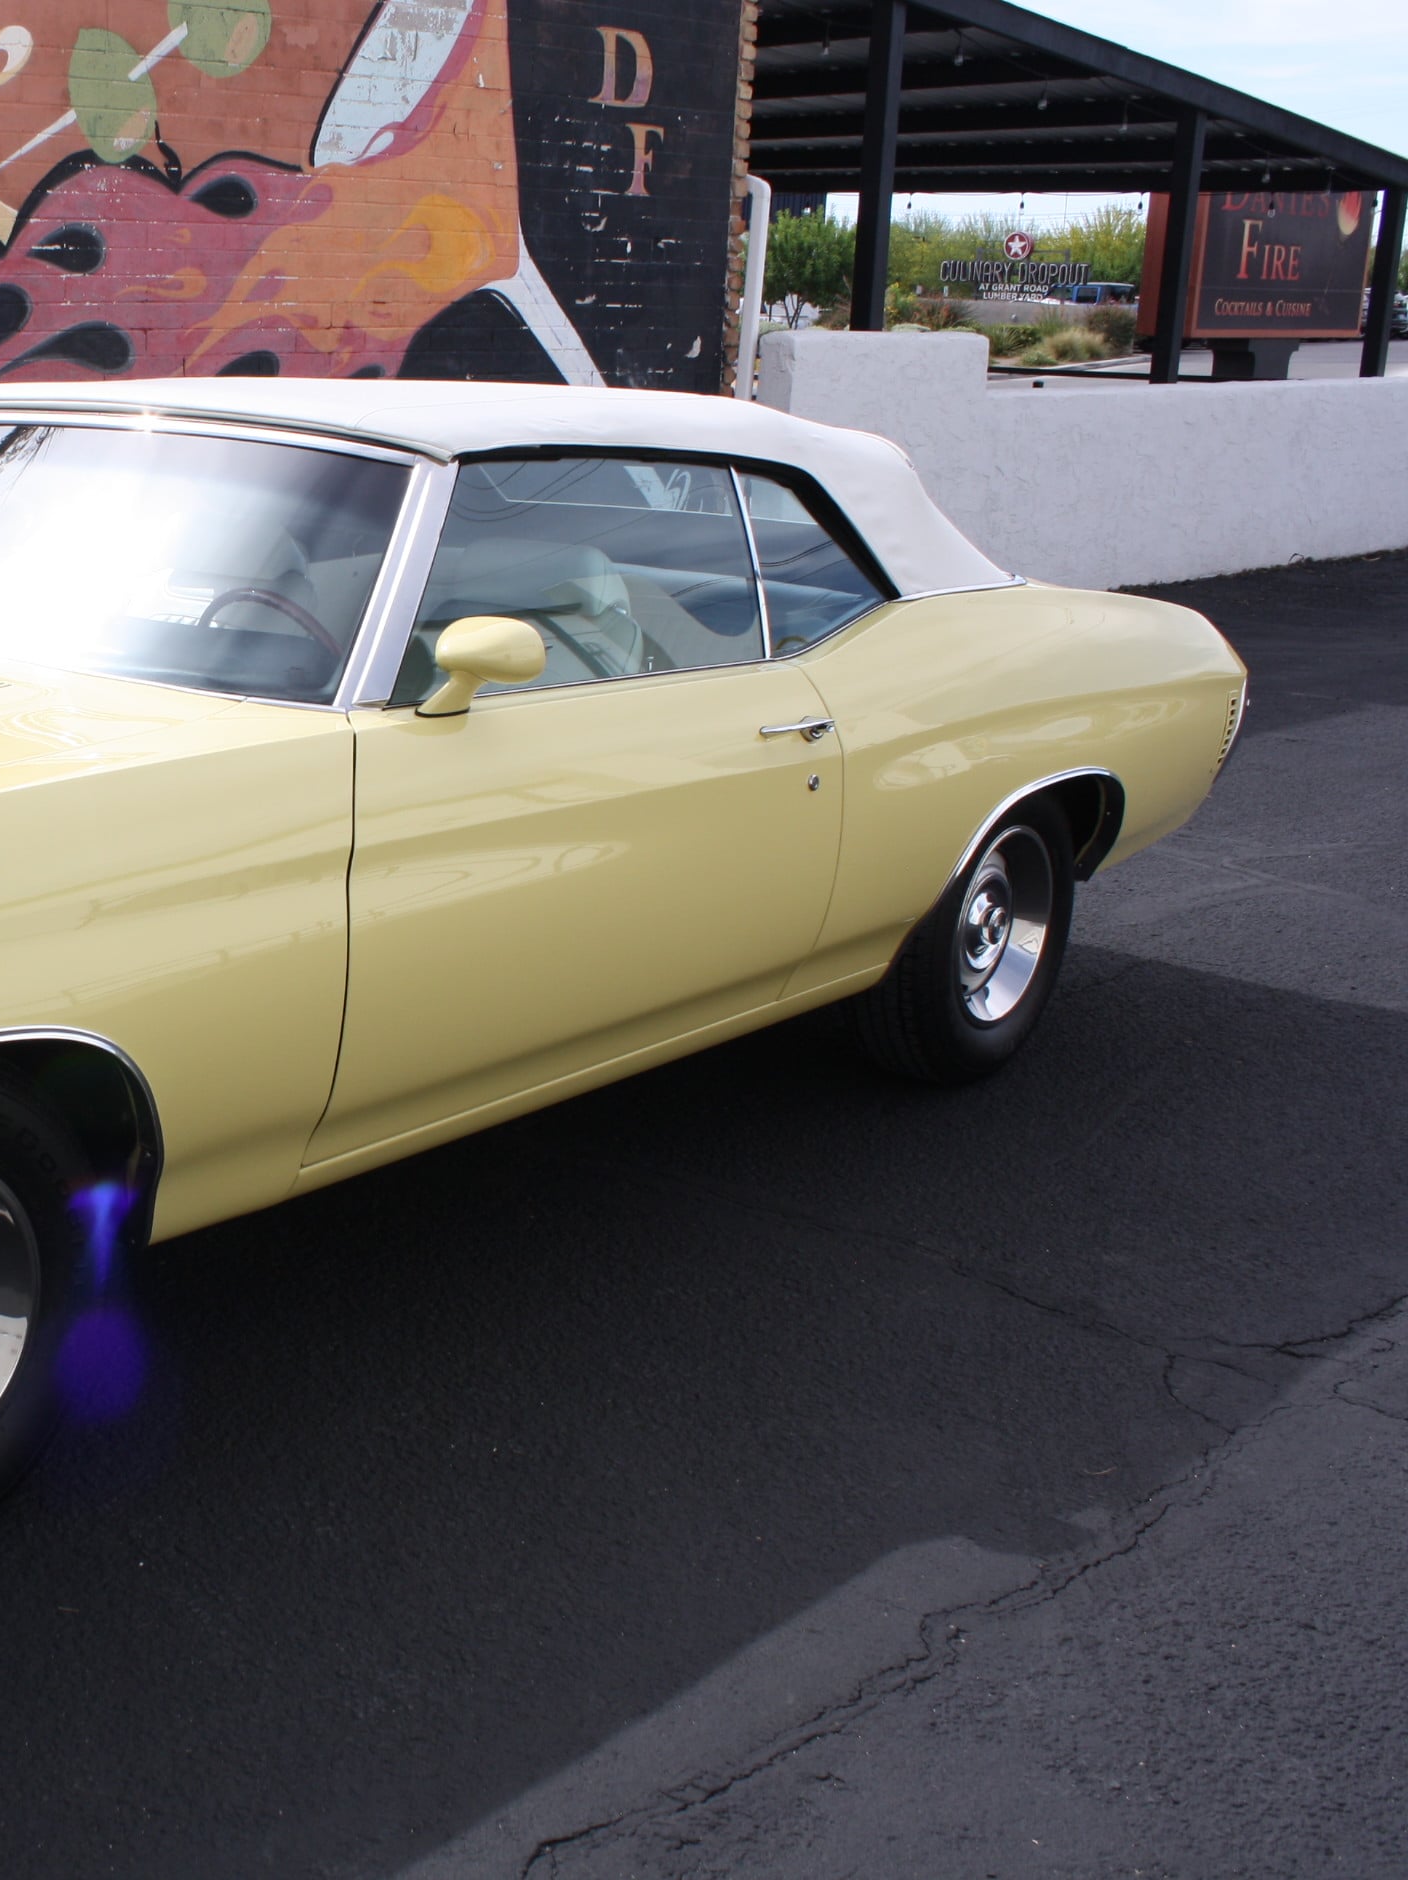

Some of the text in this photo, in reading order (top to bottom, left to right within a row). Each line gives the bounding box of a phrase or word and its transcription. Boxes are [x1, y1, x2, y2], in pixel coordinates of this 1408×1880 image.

[588, 26, 653, 107] D
[623, 123, 665, 197] F
[1235, 218, 1301, 281] FIRE
[940, 260, 1088, 285] CULINARY DROPOUT
[979, 283, 1049, 293] AT GRANT ROAD
[983, 292, 1044, 301] LUMBER YARD
[1215, 299, 1264, 316] COCKTAILS
[1275, 300, 1312, 317] CUISINE
